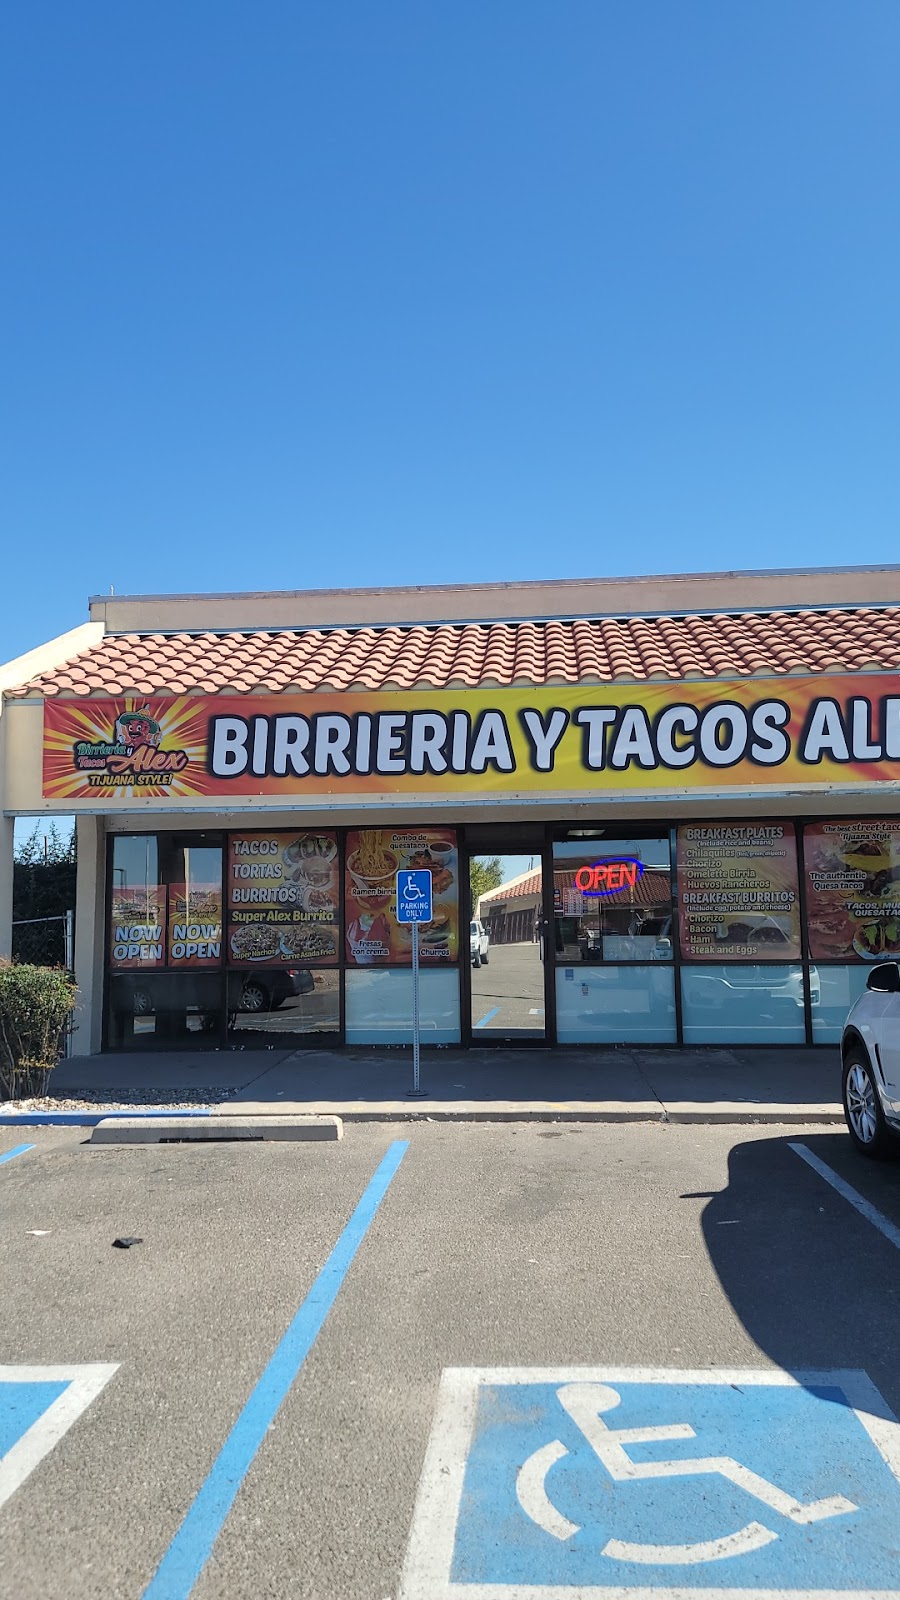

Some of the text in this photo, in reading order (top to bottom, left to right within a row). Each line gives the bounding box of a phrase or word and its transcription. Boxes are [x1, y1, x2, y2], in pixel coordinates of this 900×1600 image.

[211, 711, 515, 777] BIRRIERIA
[522, 709, 568, 770] Y
[576, 701, 790, 769] TACOS
[127, 747, 133, 757] y
[78, 756, 106, 768] Tacos
[106, 744, 187, 773] Alex
[90, 773, 174, 786] TIJUANA STYLE!
[851, 823, 880, 831] street
[392, 834, 417, 842] Combo
[687, 826, 784, 840] BREAKFAST PLATES
[842, 832, 891, 841] Tijuana Style
[232, 839, 279, 855] TACOS
[389, 842, 429, 850] quesatacos
[751, 839, 774, 848] beans)
[686, 848, 735, 859] Chilaquiles
[686, 859, 722, 869] Chorizo
[232, 863, 282, 879] TORTAS
[575, 862, 637, 890] OPEN
[687, 868, 756, 879] Omelette Birria
[810, 871, 866, 880] The authentic
[687, 880, 770, 889] Huevos Rancheros
[814, 882, 839, 890] Quesa
[231, 887, 297, 903] BURRITOS
[352, 888, 376, 896] Ramen
[682, 891, 795, 904] BREAKFAST BURRITOS
[400, 901, 429, 910] PARKING
[686, 905, 713, 913] (Include
[232, 910, 334, 924] Super Alex Burrito
[405, 909, 424, 917] ONLY
[689, 914, 724, 923] Chorizo
[115, 925, 162, 942] NOW
[173, 924, 221, 940] NOW
[690, 925, 717, 933] Bacon
[690, 935, 711, 944] Ham
[113, 944, 162, 960] OPEN
[171, 942, 220, 959] OPEN
[232, 949, 276, 960] Super Nachos
[280, 953, 301, 961] Carne
[300, 950, 319, 958] Asada
[420, 948, 450, 956] Churros
[690, 946, 757, 955] Steak and Eggs
